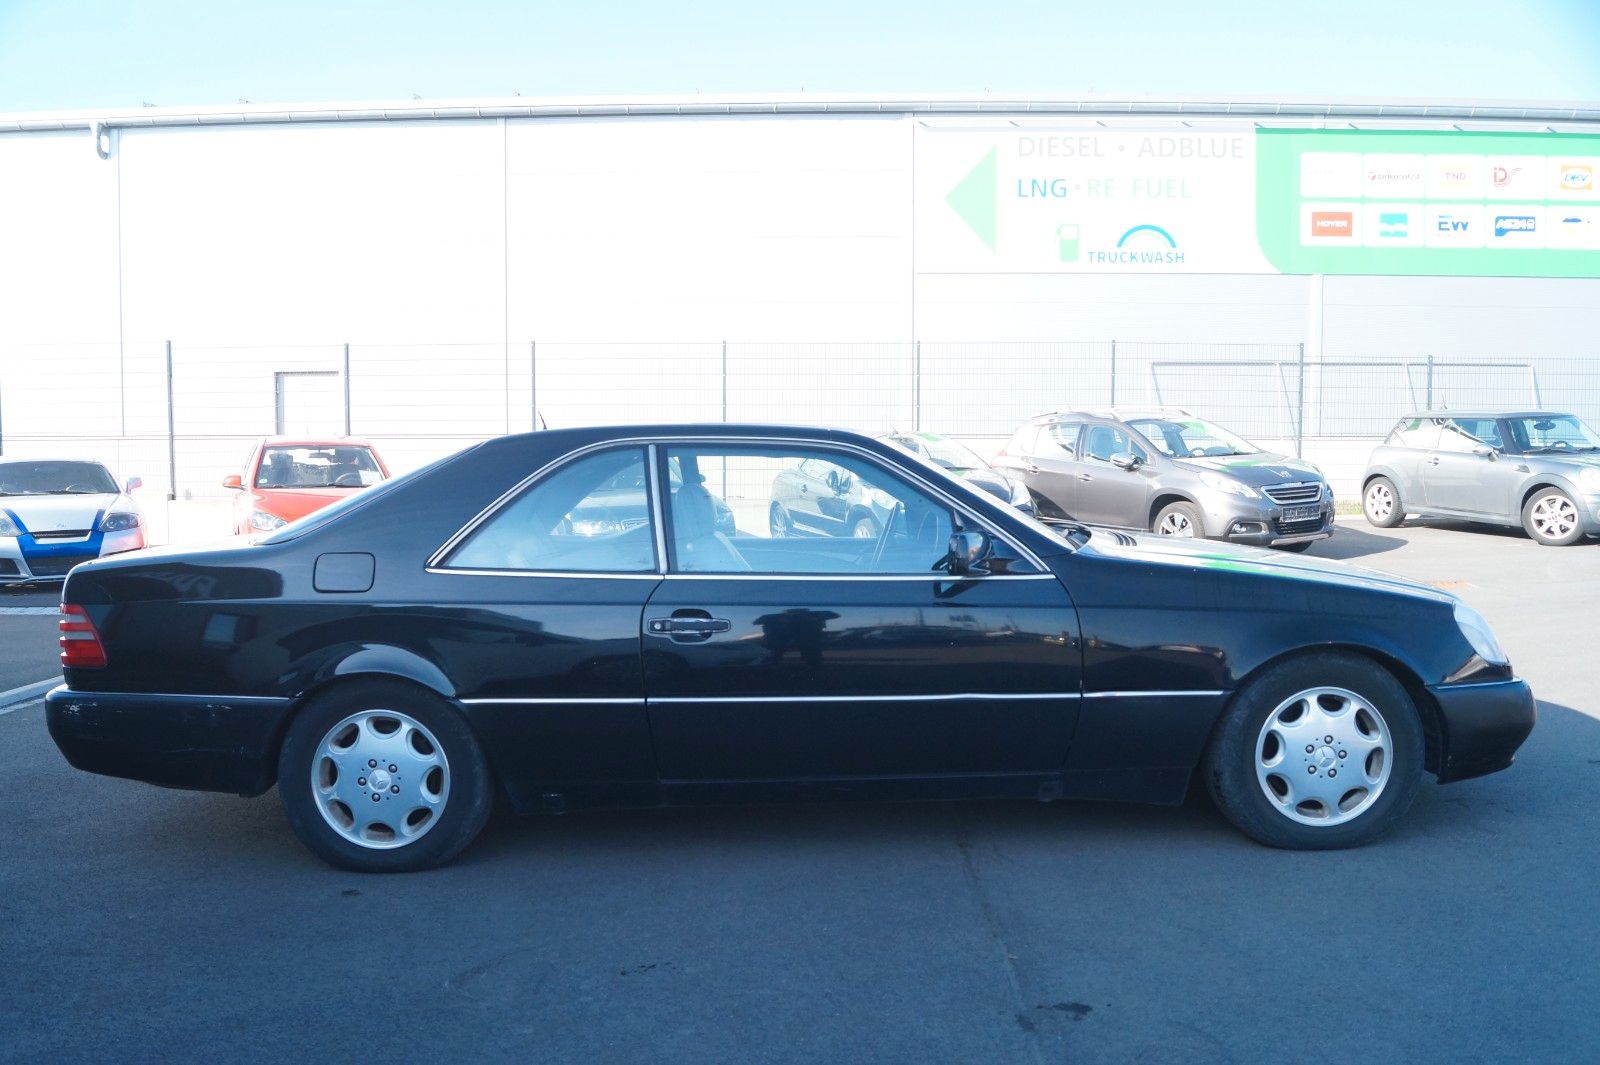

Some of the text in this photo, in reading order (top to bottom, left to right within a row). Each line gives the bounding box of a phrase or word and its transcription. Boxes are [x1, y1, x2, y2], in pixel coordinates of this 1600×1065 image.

[1018, 136, 1243, 159] DIESEL ADBLUE
[1018, 178, 1192, 198] LNG RE FUEL
[1088, 251, 1185, 264] TRUCKWASH
